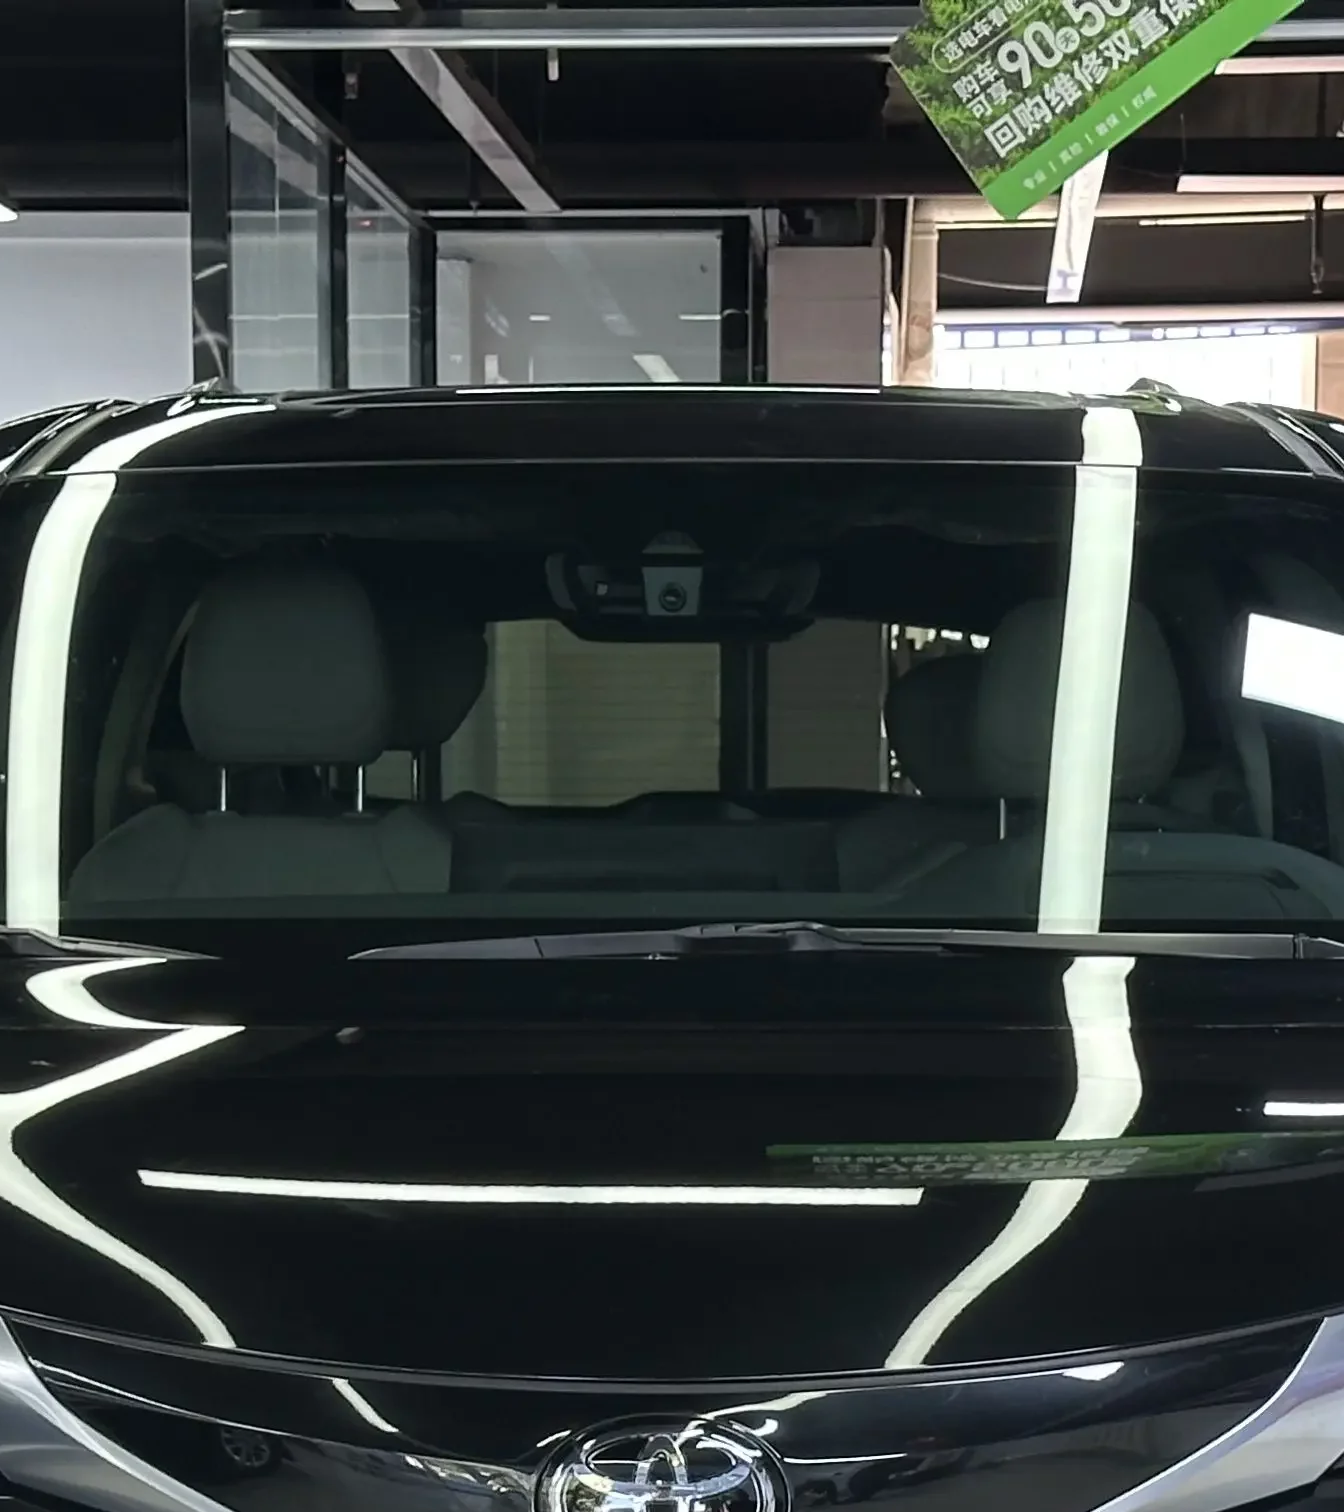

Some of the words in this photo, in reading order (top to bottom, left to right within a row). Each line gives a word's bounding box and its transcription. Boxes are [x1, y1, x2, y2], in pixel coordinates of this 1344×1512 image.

[940, 0, 1030, 63] 选电车看电
[952, 56, 1000, 103] 购车
[966, 78, 1013, 118] 可享
[984, 0, 1205, 159] 回购维修双重保
